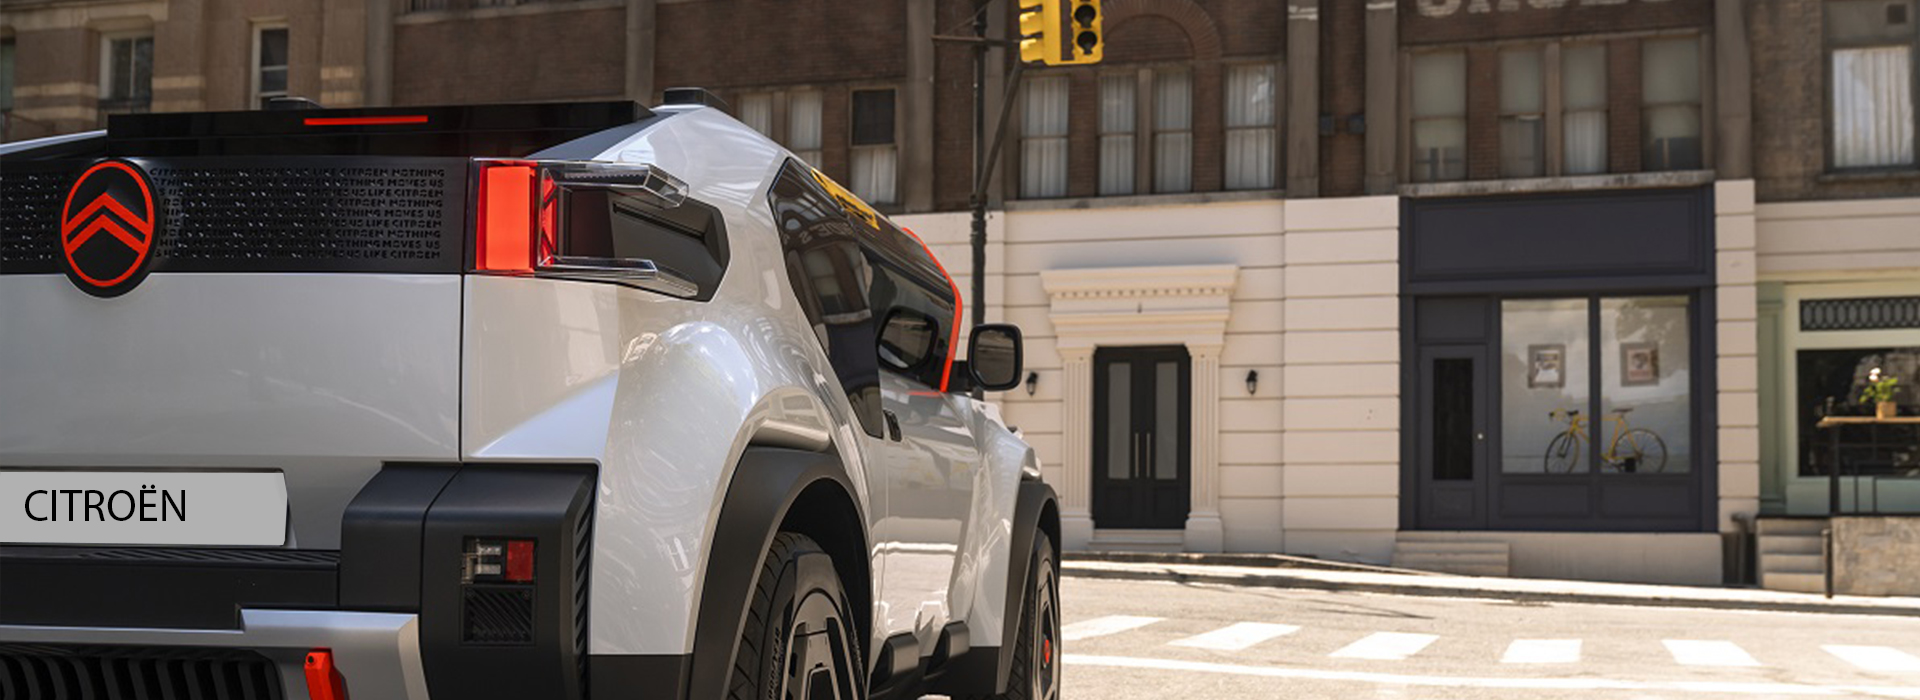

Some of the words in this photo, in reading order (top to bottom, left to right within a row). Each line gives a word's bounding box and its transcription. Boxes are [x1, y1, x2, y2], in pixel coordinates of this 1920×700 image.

[391, 168, 445, 177] NOTHING
[387, 179, 427, 188] MOVES
[429, 179, 445, 188] US
[368, 189, 391, 197] LIKE
[389, 199, 443, 208] NOTHING
[384, 209, 424, 218] MOVES
[427, 209, 442, 218] US
[366, 219, 389, 228] LIKE
[387, 229, 441, 238] NOTHING
[382, 240, 421, 249] MOVES
[425, 240, 440, 249] US
[363, 250, 387, 258] LIKE
[24, 484, 186, 522] CITROËN
